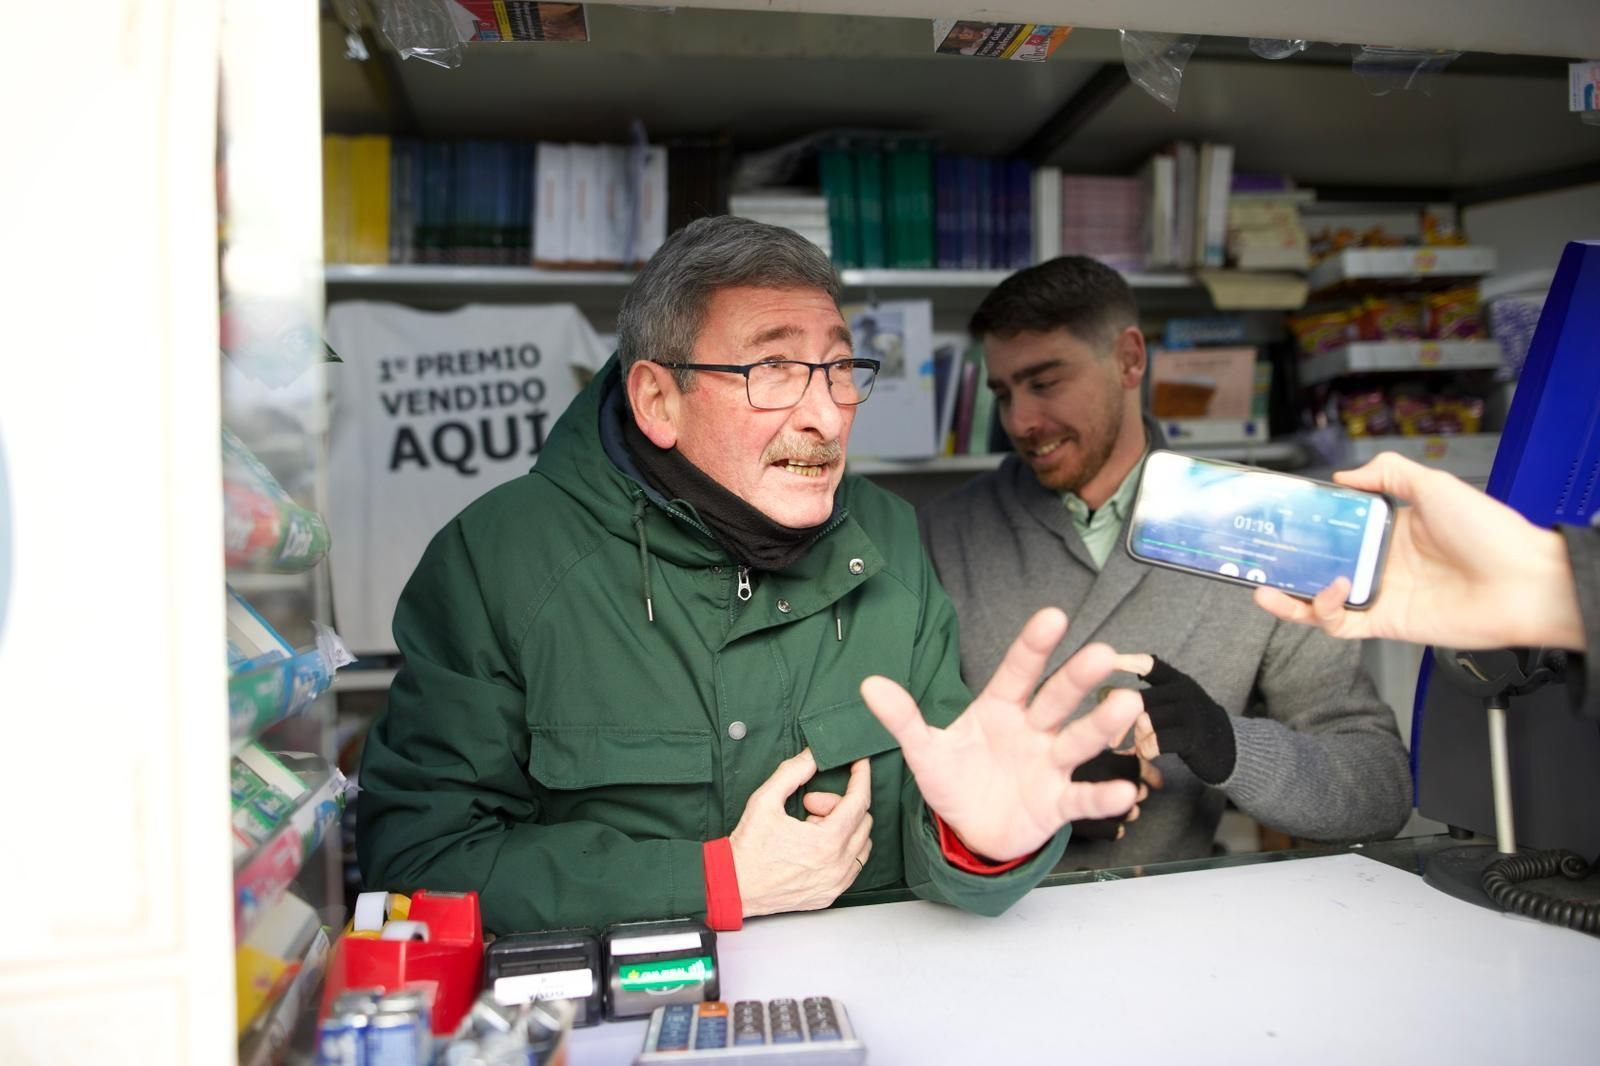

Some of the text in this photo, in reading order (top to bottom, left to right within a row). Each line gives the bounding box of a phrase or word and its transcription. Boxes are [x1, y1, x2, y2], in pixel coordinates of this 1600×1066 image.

[416, 343, 541, 379] PREMIO
[381, 377, 546, 417] VENDIDO
[1233, 515, 1275, 535] 01:19
